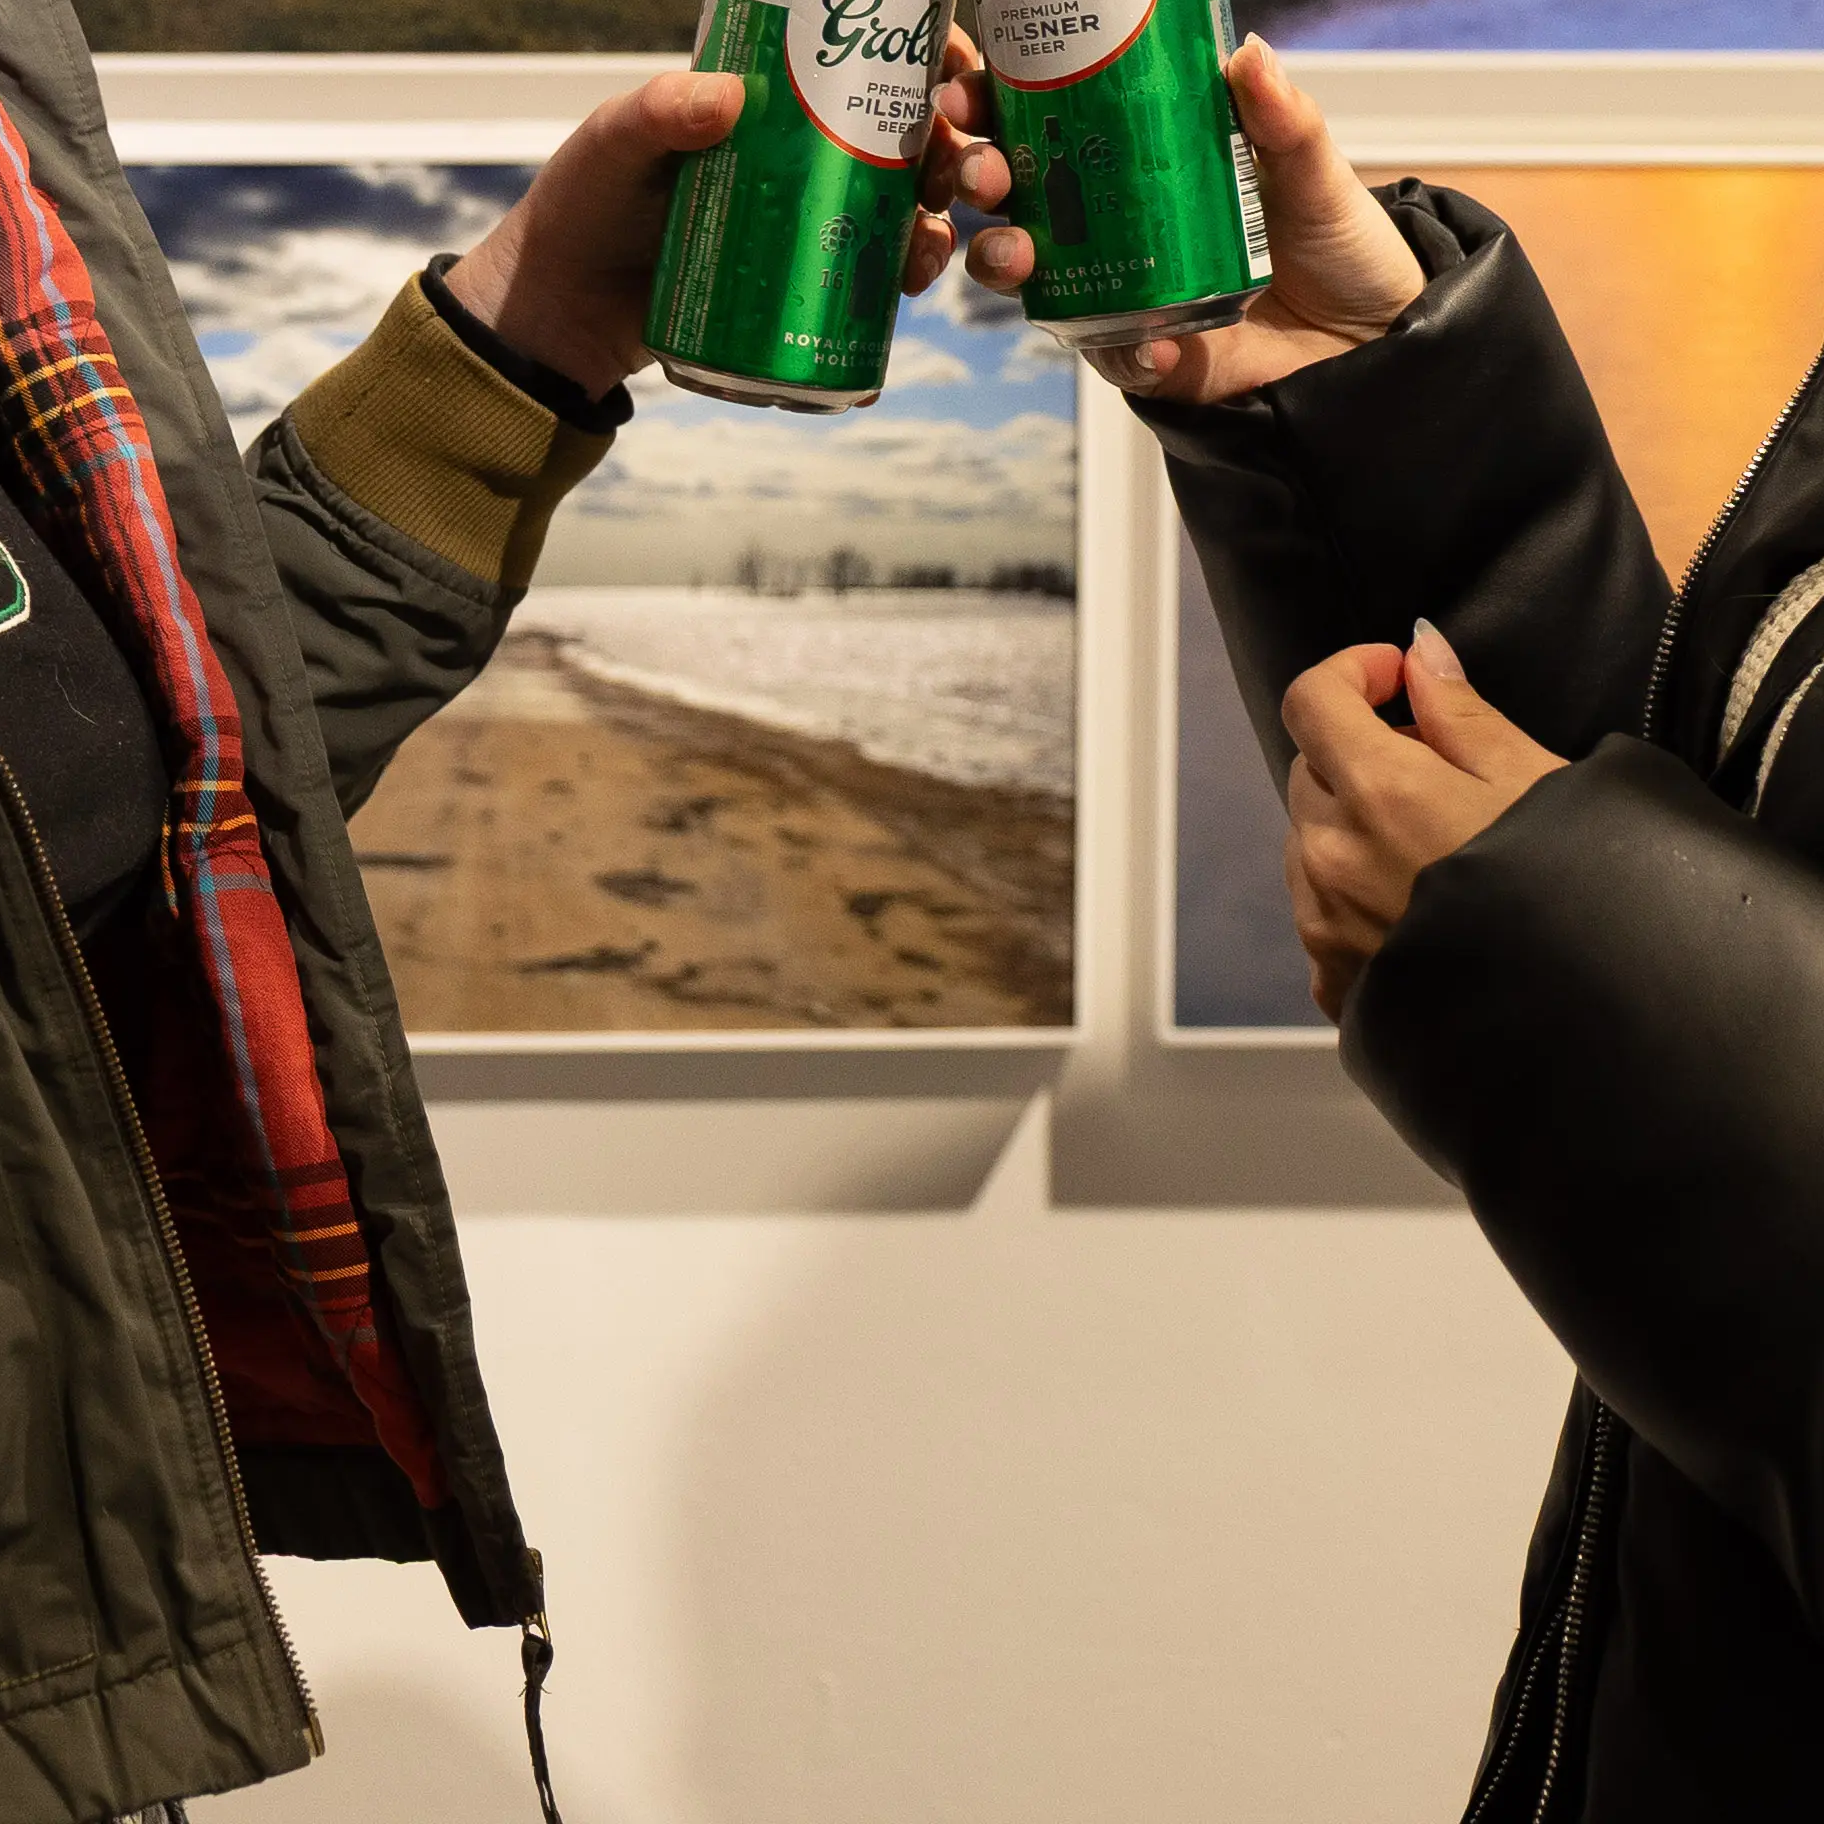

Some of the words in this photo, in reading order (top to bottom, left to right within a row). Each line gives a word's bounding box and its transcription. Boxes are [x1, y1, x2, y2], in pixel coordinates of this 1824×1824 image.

[1000, 0, 1080, 22] PREMIUM
[993, 14, 1101, 43] PILSNER
[1020, 39, 1066, 57] BEER
[846, 95, 930, 120] PILSNE
[877, 120, 915, 134] BEER
[1065, 255, 1156, 280] GROLSCH
[820, 268, 844, 291] 16
[784, 332, 843, 351] ROYAL
